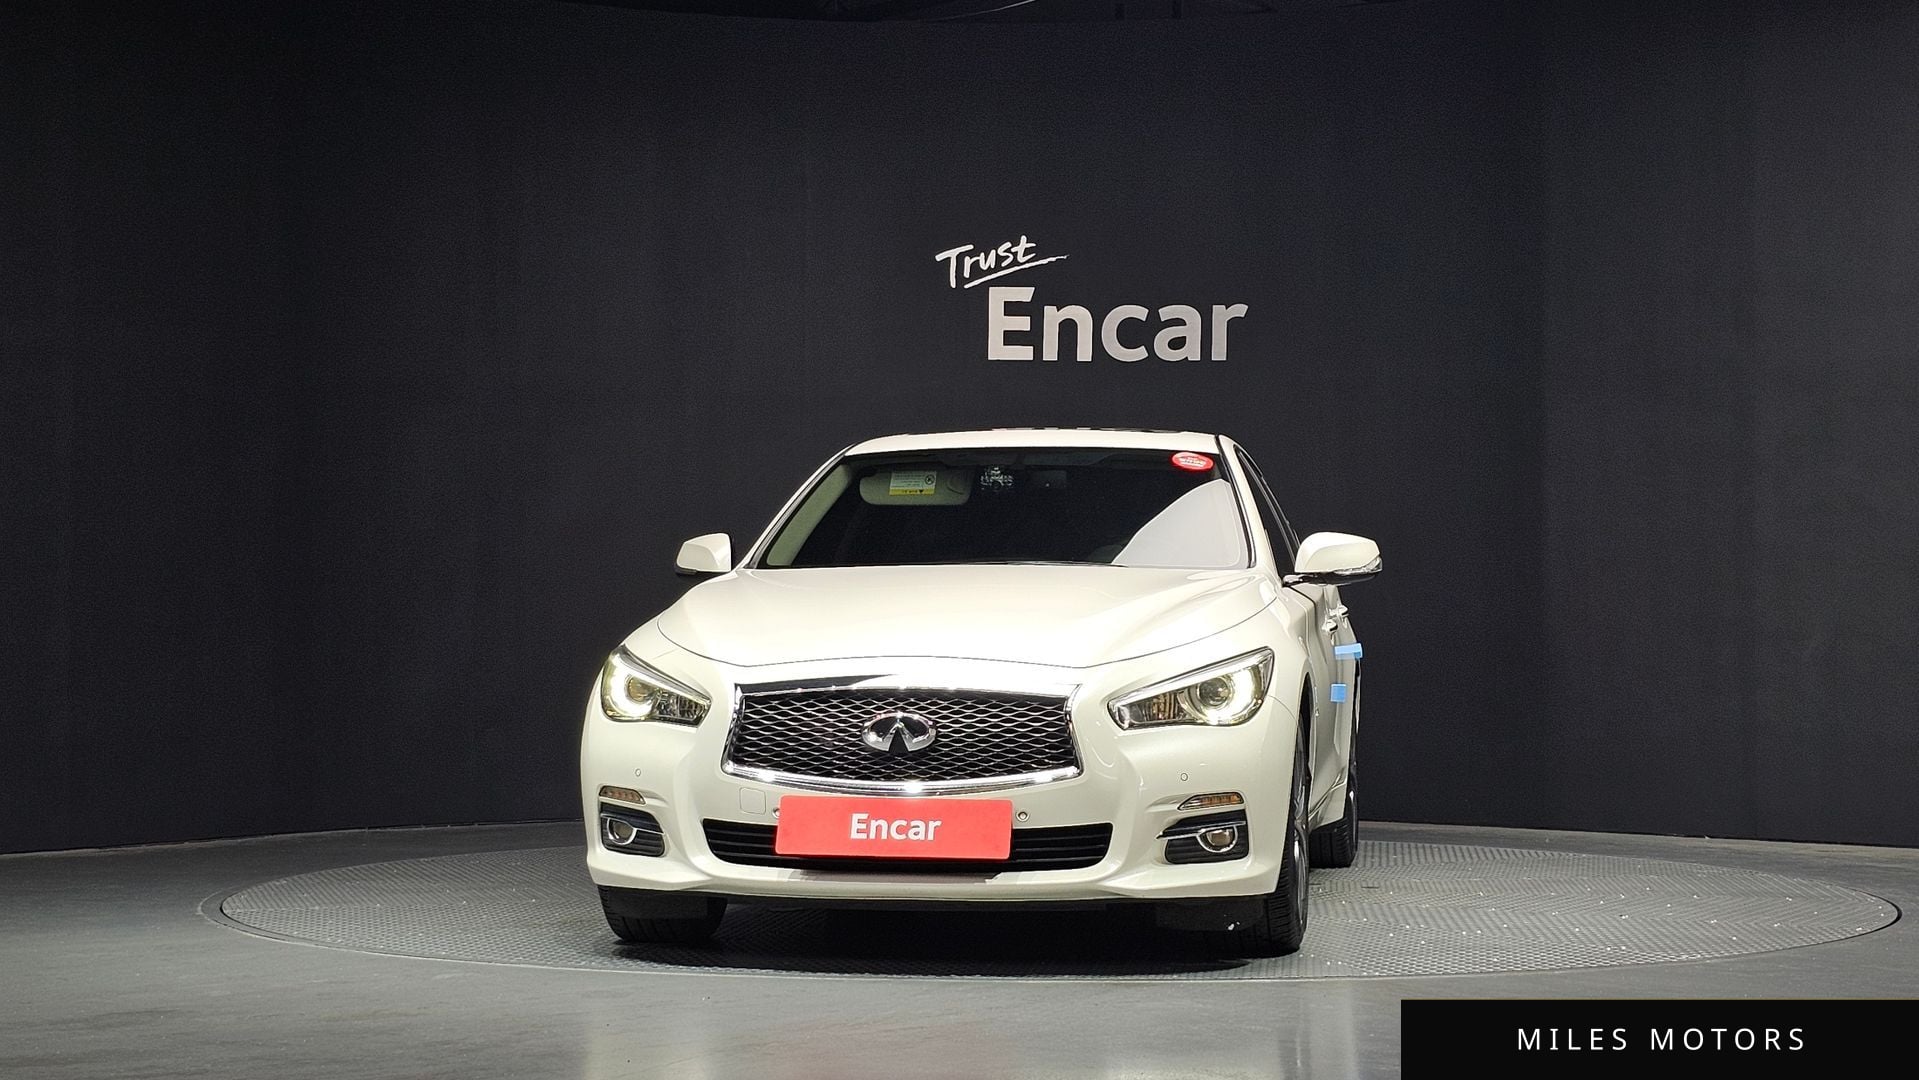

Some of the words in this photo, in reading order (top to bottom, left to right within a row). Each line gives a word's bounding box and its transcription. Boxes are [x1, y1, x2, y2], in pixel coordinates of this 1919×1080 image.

[935, 235, 1037, 289] Trust
[987, 286, 1249, 362] Encar
[850, 813, 942, 841] Encar
